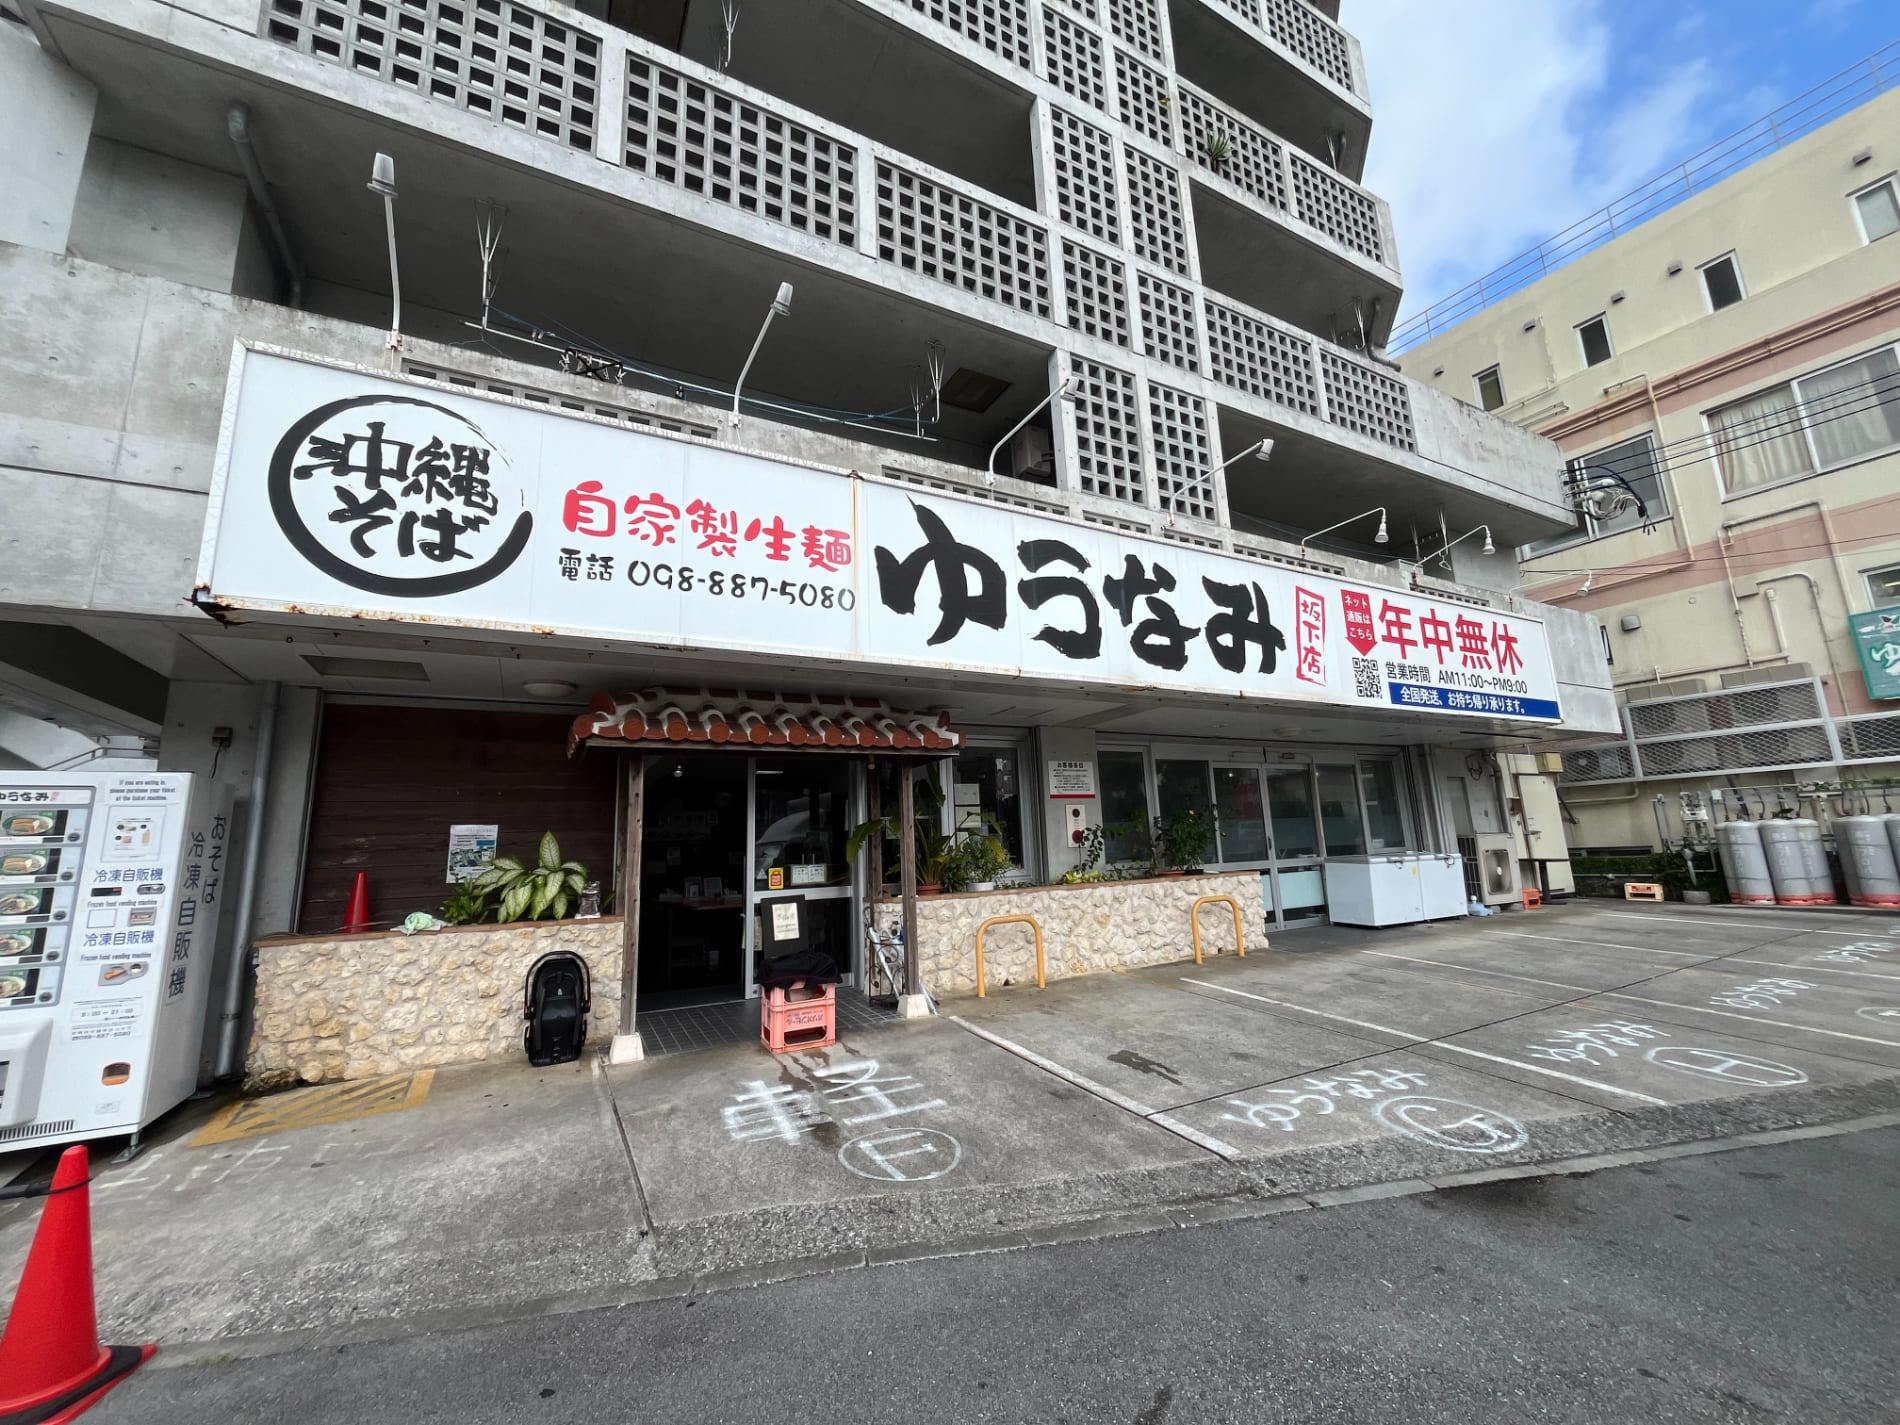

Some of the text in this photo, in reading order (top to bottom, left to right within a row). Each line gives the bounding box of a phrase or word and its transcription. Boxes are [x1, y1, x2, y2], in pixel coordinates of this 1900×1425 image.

[293, 421, 499, 517] 沖縄
[327, 486, 490, 563] そば
[562, 480, 853, 573] 自家製生麺
[558, 547, 856, 614] 電話 098-887-5080
[874, 494, 1287, 676] ゆうなみ
[1344, 594, 1368, 609] ネット
[1300, 599, 1322, 675] 坂下店
[1346, 611, 1371, 625] 通販は
[1349, 627, 1373, 641] こちら
[1378, 598, 1524, 676] 年中無休
[1385, 660, 1431, 684] 営業時間
[93, 867, 164, 883] 冷凍自販機
[201, 814, 227, 905] おそば
[83, 930, 154, 947] 冷凍自販機
[166, 831, 206, 999] 冷凍自販機
[1219, 1068, 1427, 1132] ゆうなみ
